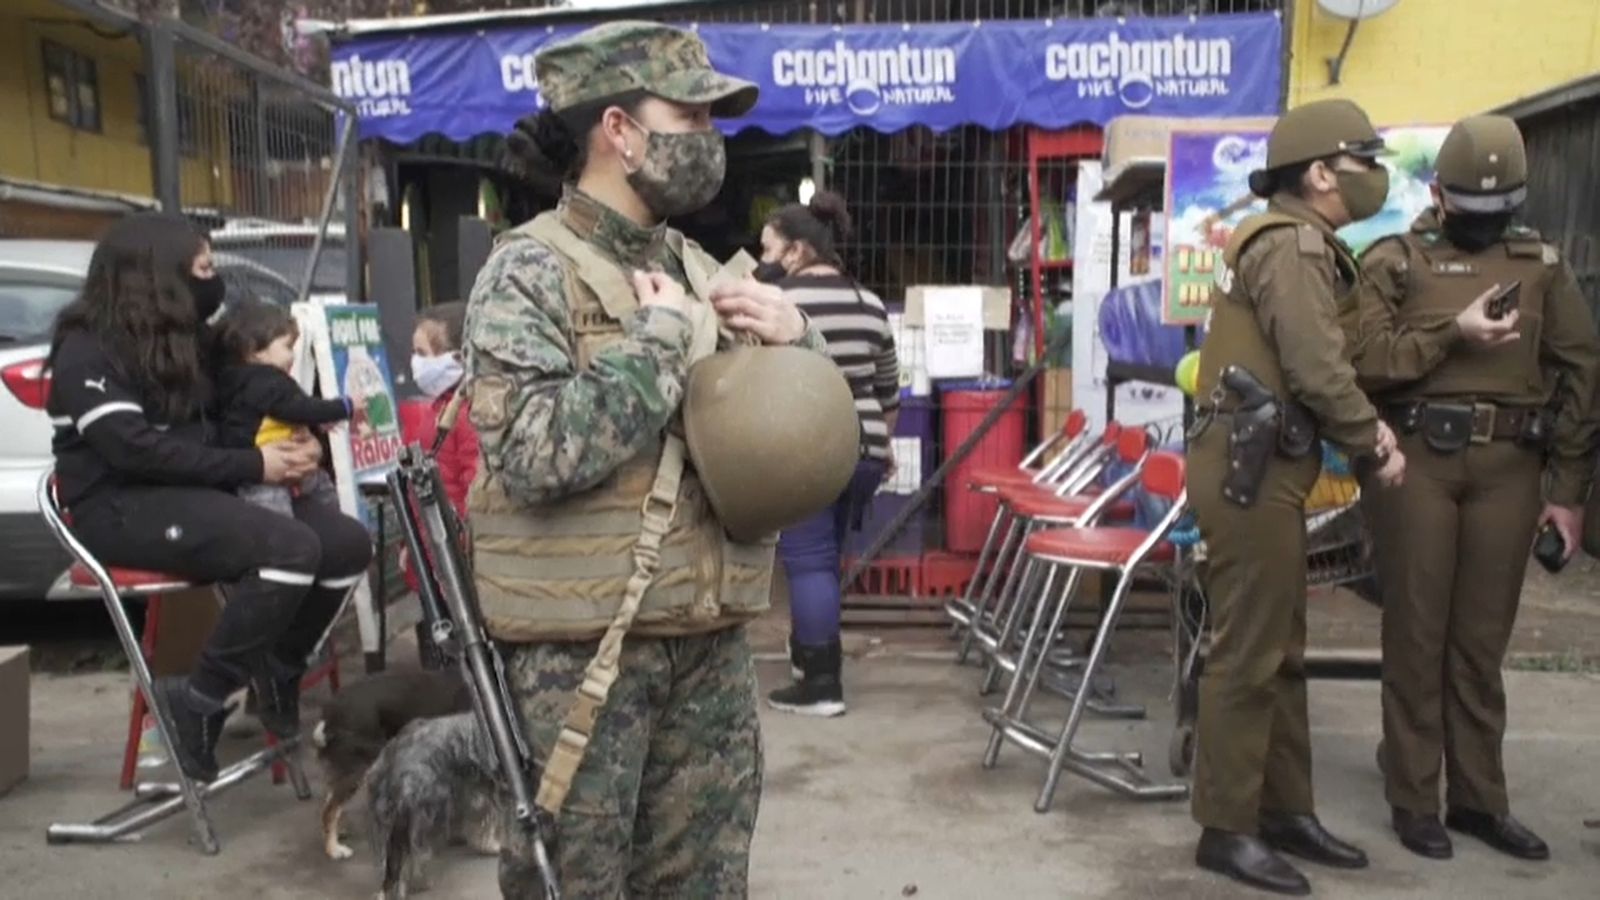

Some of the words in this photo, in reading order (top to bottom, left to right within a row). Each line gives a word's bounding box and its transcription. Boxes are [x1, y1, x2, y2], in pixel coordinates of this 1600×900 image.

[772, 39, 955, 87] cachantun
[1046, 31, 1231, 80] cachantun
[883, 86, 955, 105] NATURAL
[1156, 78, 1230, 97] NATURAL
